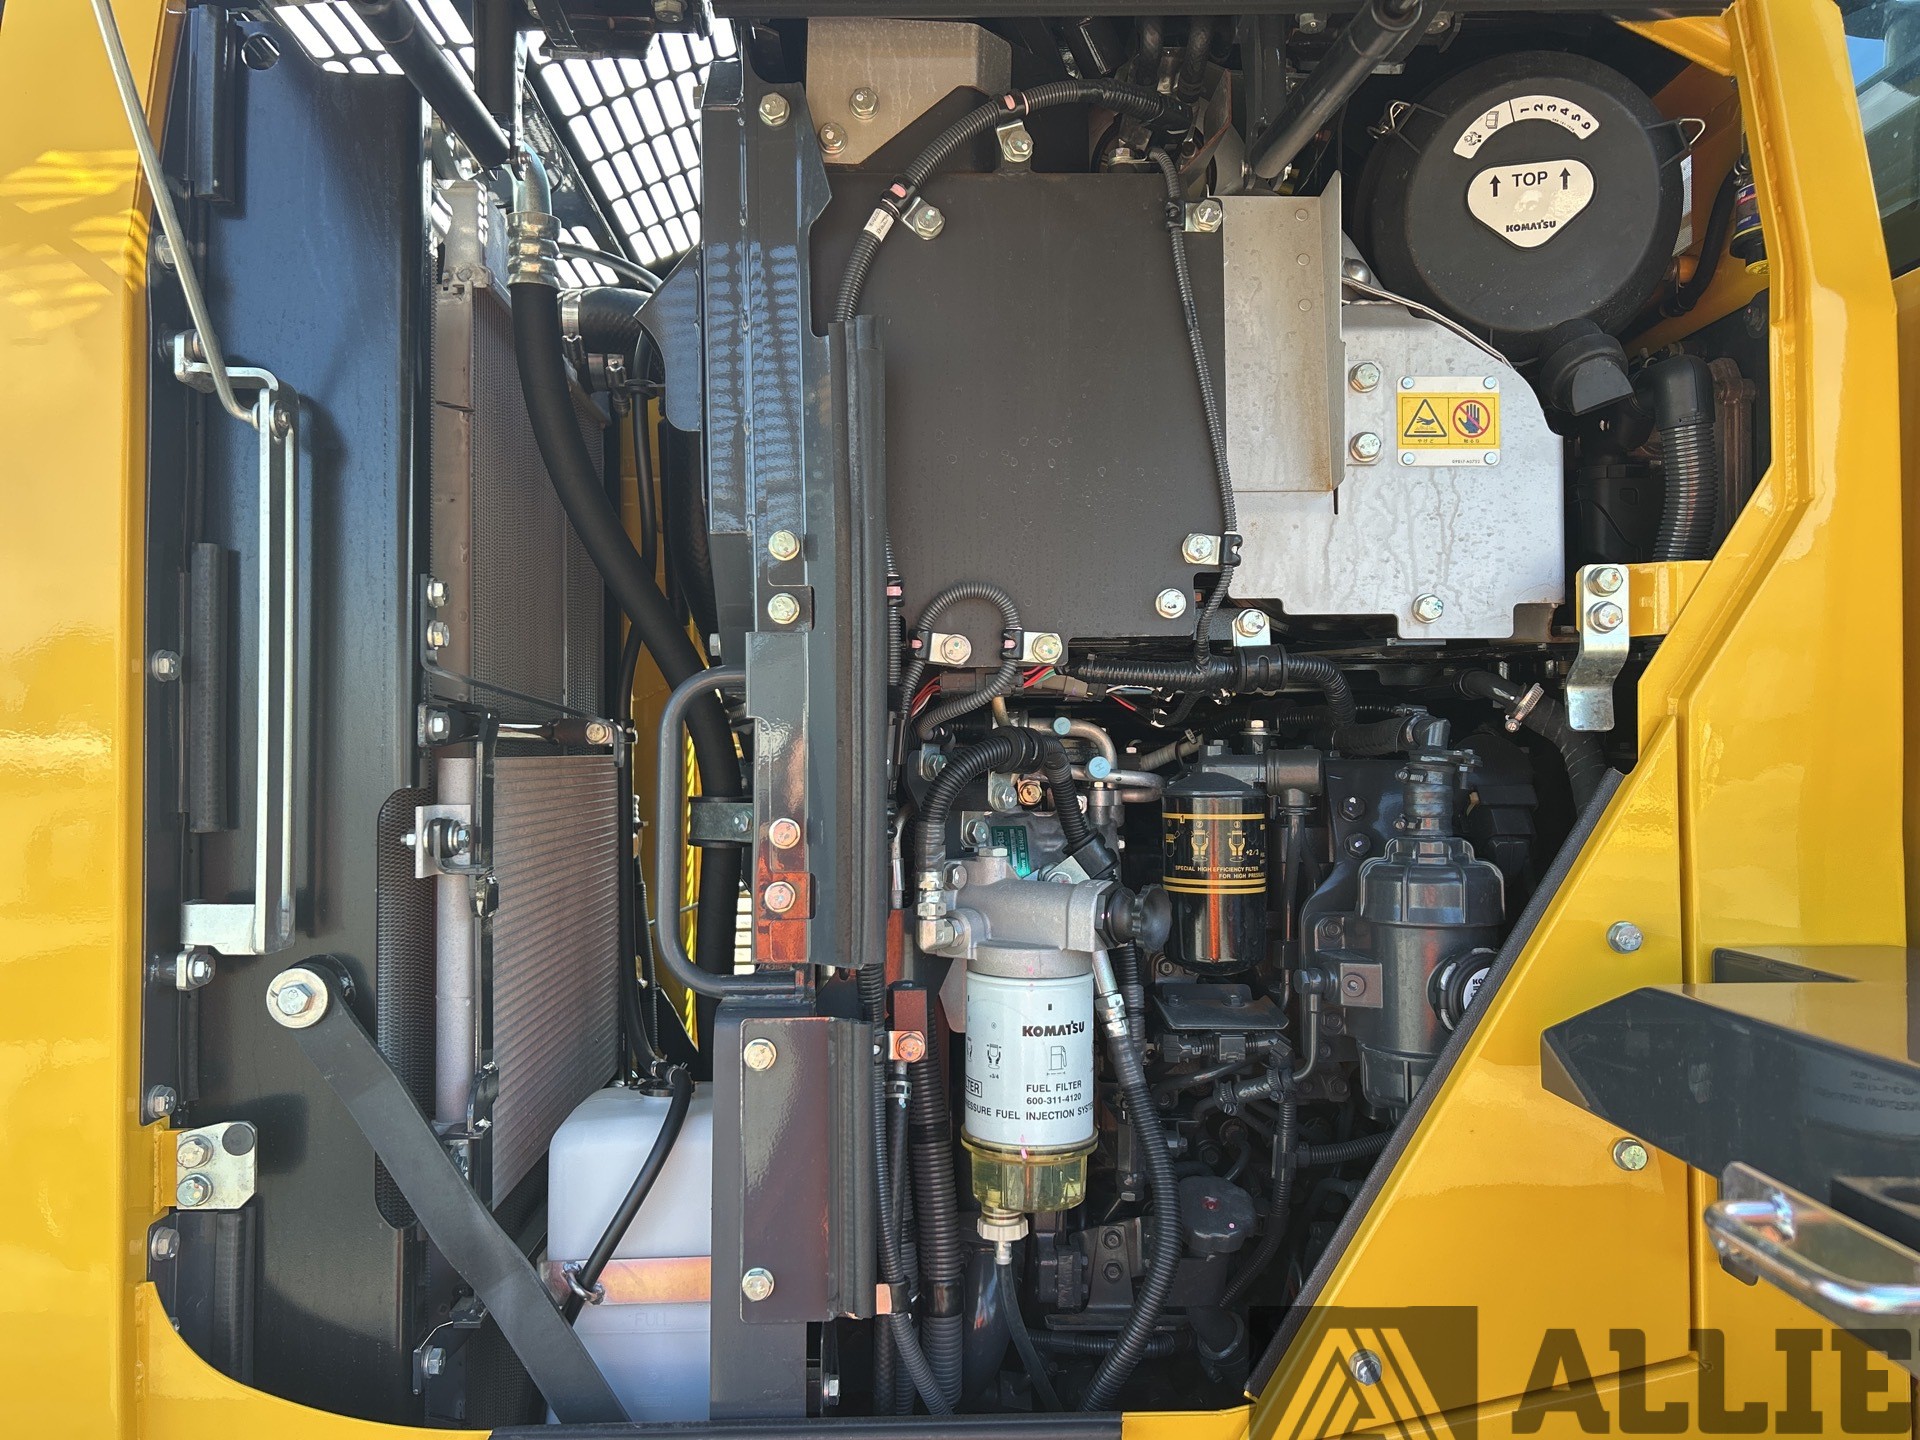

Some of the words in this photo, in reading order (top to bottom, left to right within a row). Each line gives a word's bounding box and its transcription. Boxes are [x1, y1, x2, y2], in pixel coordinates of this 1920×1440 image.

[1511, 171, 1548, 188] TOP
[1505, 219, 1556, 233] KOMATSU
[1175, 864, 1195, 872] SPECIAL
[1022, 1020, 1085, 1037] KOMATSU
[1026, 1084, 1051, 1093] FUEL
[1055, 1080, 1082, 1092] FILTER
[1026, 1093, 1082, 1105] 600-311-4120
[995, 1109, 1020, 1120] FUEL
[1025, 1108, 1075, 1121] INJECTION
